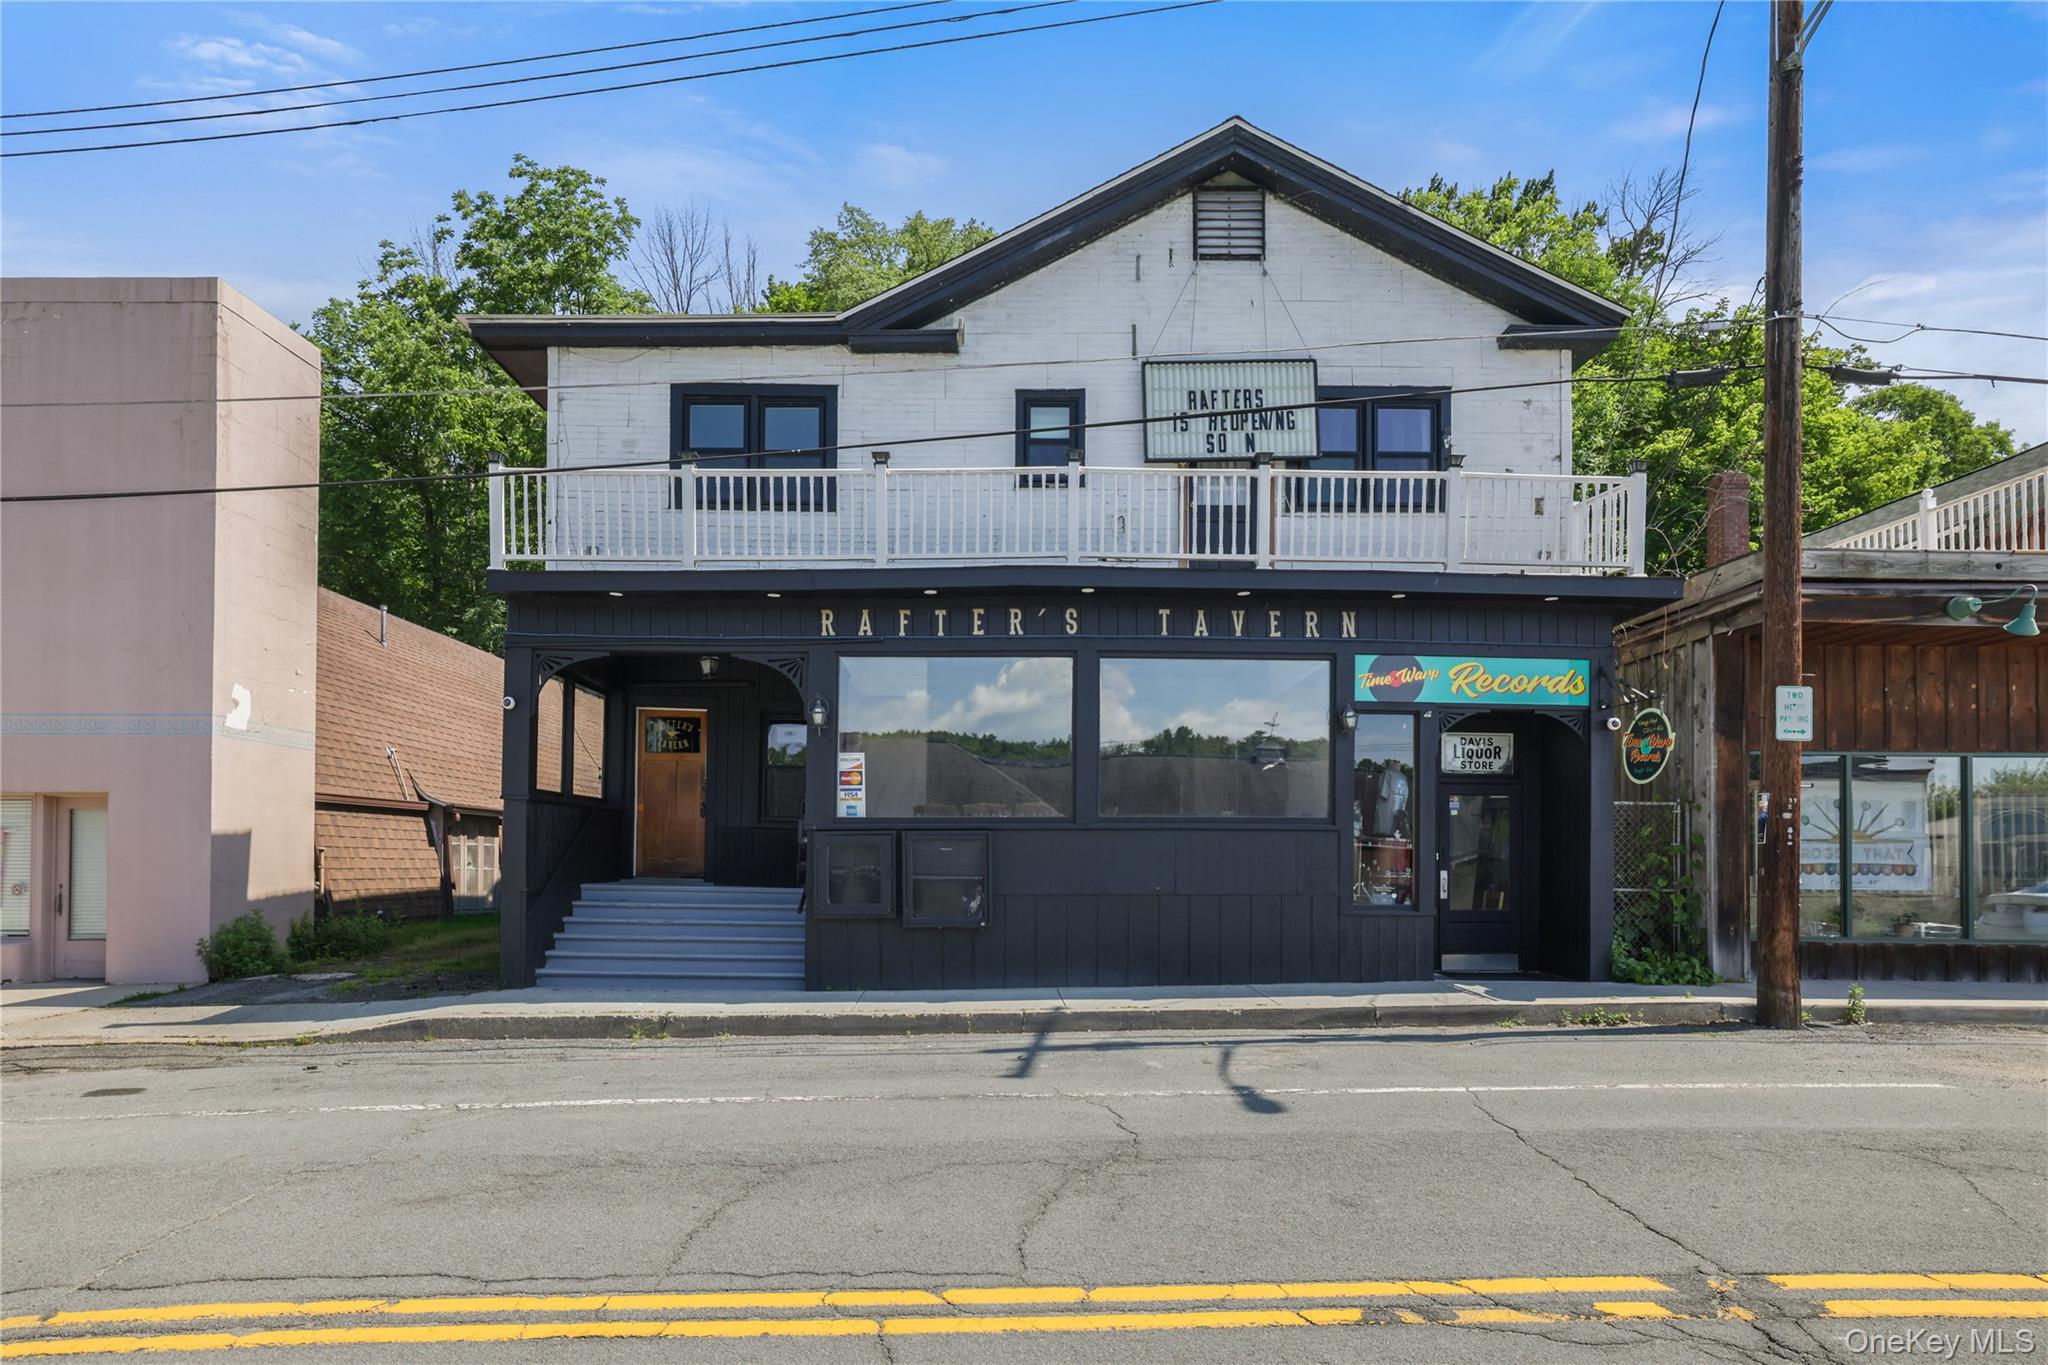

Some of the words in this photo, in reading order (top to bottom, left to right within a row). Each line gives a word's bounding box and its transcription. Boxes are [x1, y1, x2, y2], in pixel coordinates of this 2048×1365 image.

[1188, 389, 1263, 410] RAFTERS
[1173, 411, 1188, 432] IS
[820, 607, 1079, 637] RAFTER'S
[1158, 608, 1358, 638] TAVERN
[1358, 672, 1393, 689] Time
[1395, 666, 1440, 687] Warp
[1448, 661, 1587, 699] Records
[1459, 737, 1494, 746] DAVIS
[1453, 744, 1502, 760] LIQUOR
[1460, 761, 1495, 770] STORE
[1863, 847, 1904, 860] THAT
